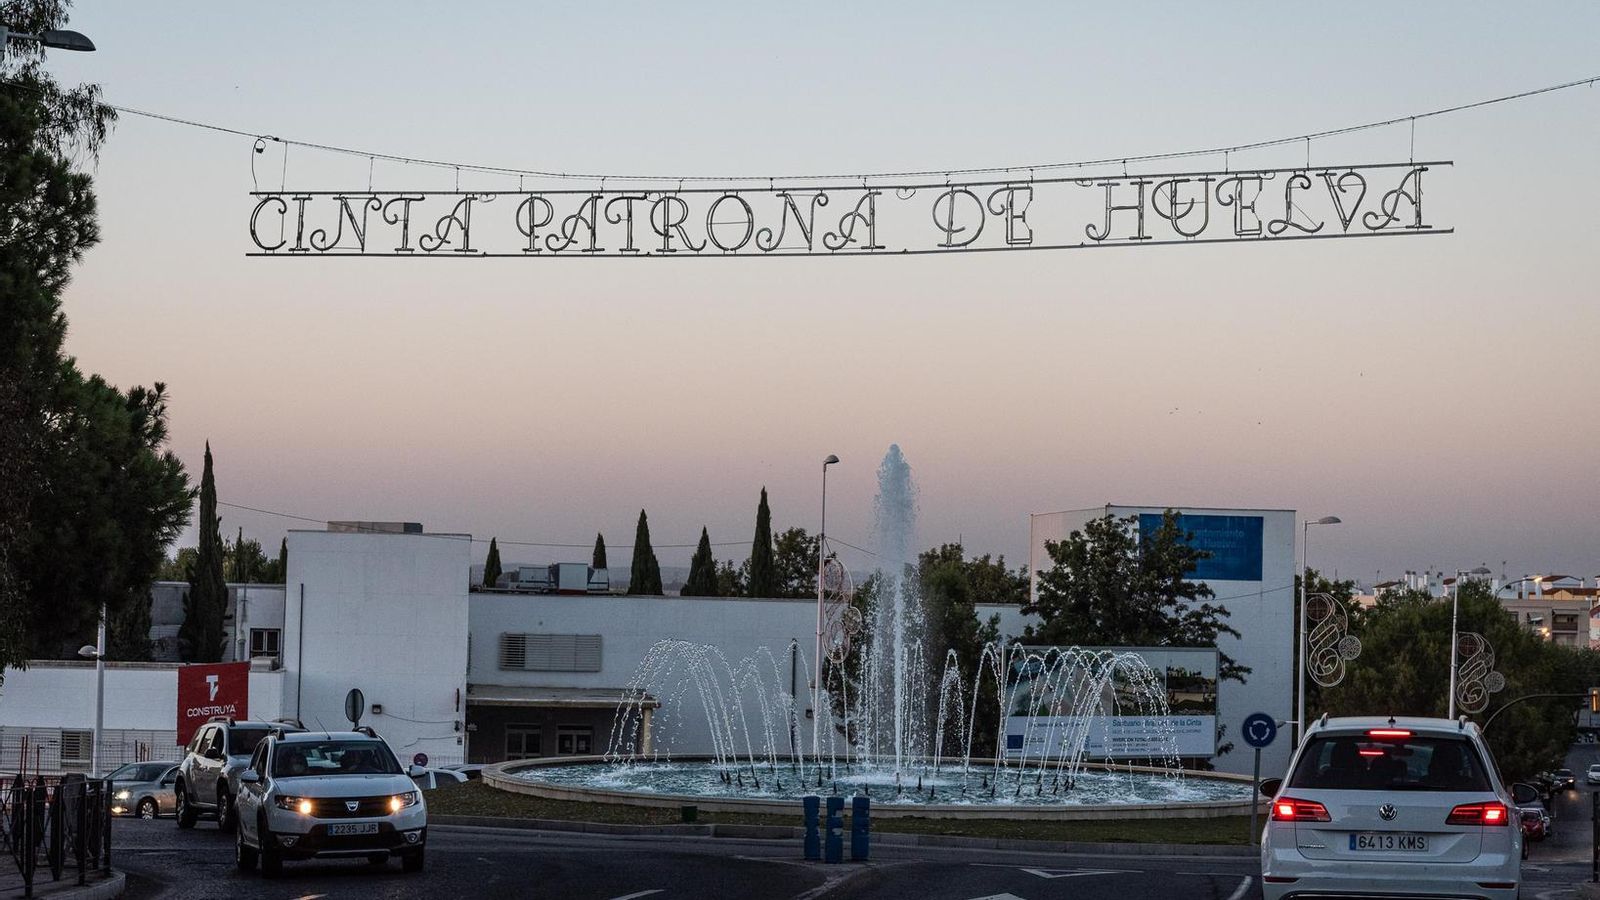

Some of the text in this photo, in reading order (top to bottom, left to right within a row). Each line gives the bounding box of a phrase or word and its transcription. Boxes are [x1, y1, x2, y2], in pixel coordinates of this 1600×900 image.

[249, 168, 1429, 252] CINTA PATRONA DE HUELVA
[187, 704, 236, 717] CONSTRUYA
[335, 822, 377, 834] 2235 JJR
[1359, 836, 1425, 849] 6413 KMS
